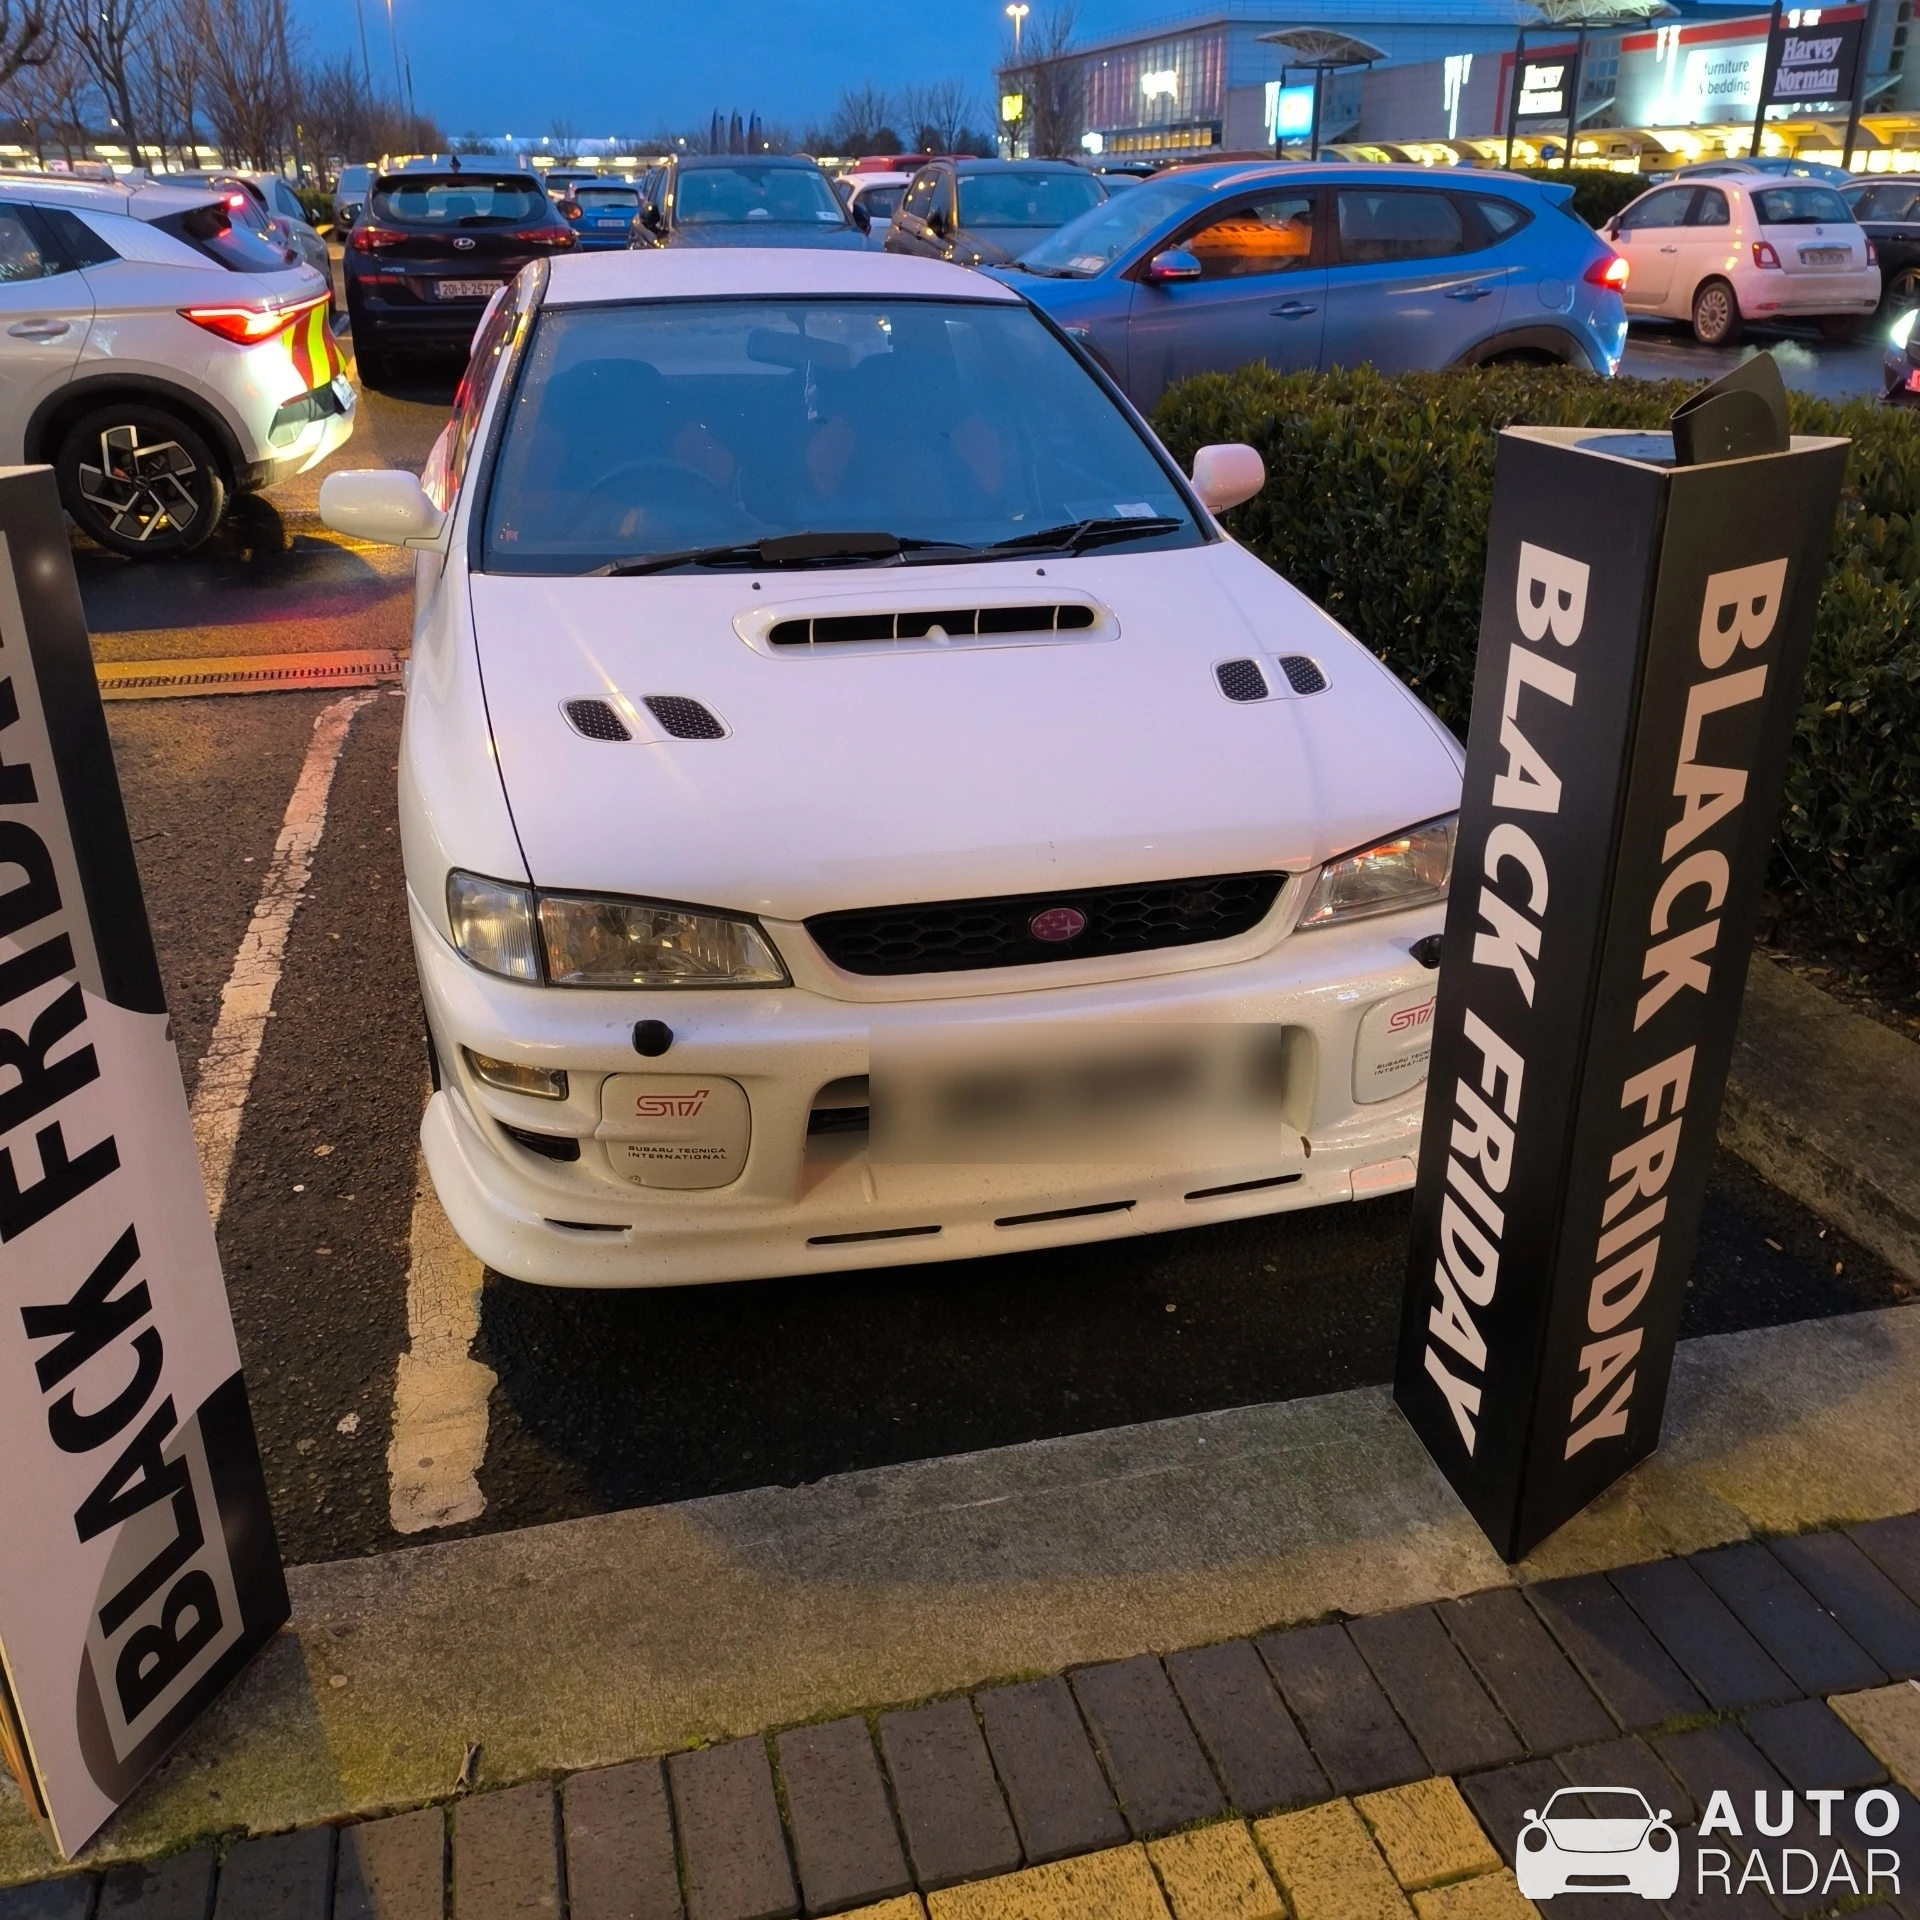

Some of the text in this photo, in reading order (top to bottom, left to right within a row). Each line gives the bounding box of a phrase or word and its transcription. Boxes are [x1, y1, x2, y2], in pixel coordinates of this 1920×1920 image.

[1781, 37, 1843, 66] Harvey
[1773, 67, 1840, 95] Norman
[1424, 541, 1591, 1458] BLACK FRIDAY
[1564, 557, 1789, 1461] BLACK FRIDAY
[1374, 1055, 1430, 1076] INTERNATION
[1376, 1049, 1430, 1070] SUBARU TECN
[628, 1145, 674, 1153] SUBARU
[628, 1152, 727, 1160] INTERNATIONAL
[0, 628, 224, 1726] BLACK FRID
